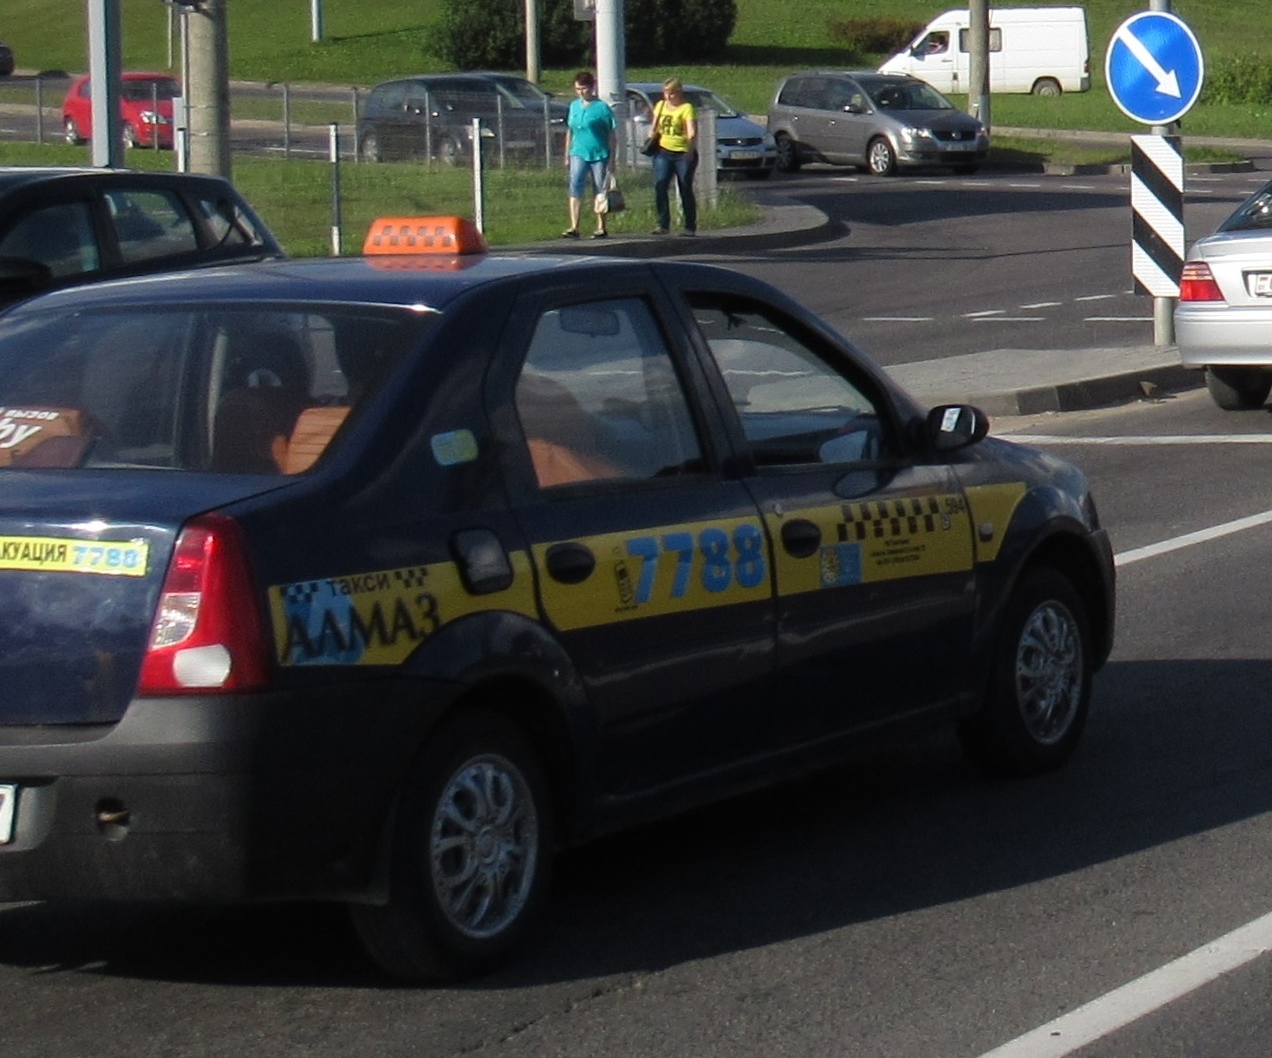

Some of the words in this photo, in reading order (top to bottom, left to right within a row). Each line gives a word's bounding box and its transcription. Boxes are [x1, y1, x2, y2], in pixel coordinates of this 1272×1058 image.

[0, 542, 68, 566] КУАЦИЯ
[72, 545, 140, 568] 7788
[627, 523, 765, 604] 7788
[326, 573, 391, 597] такси
[281, 592, 441, 666] АЛМАЗ
